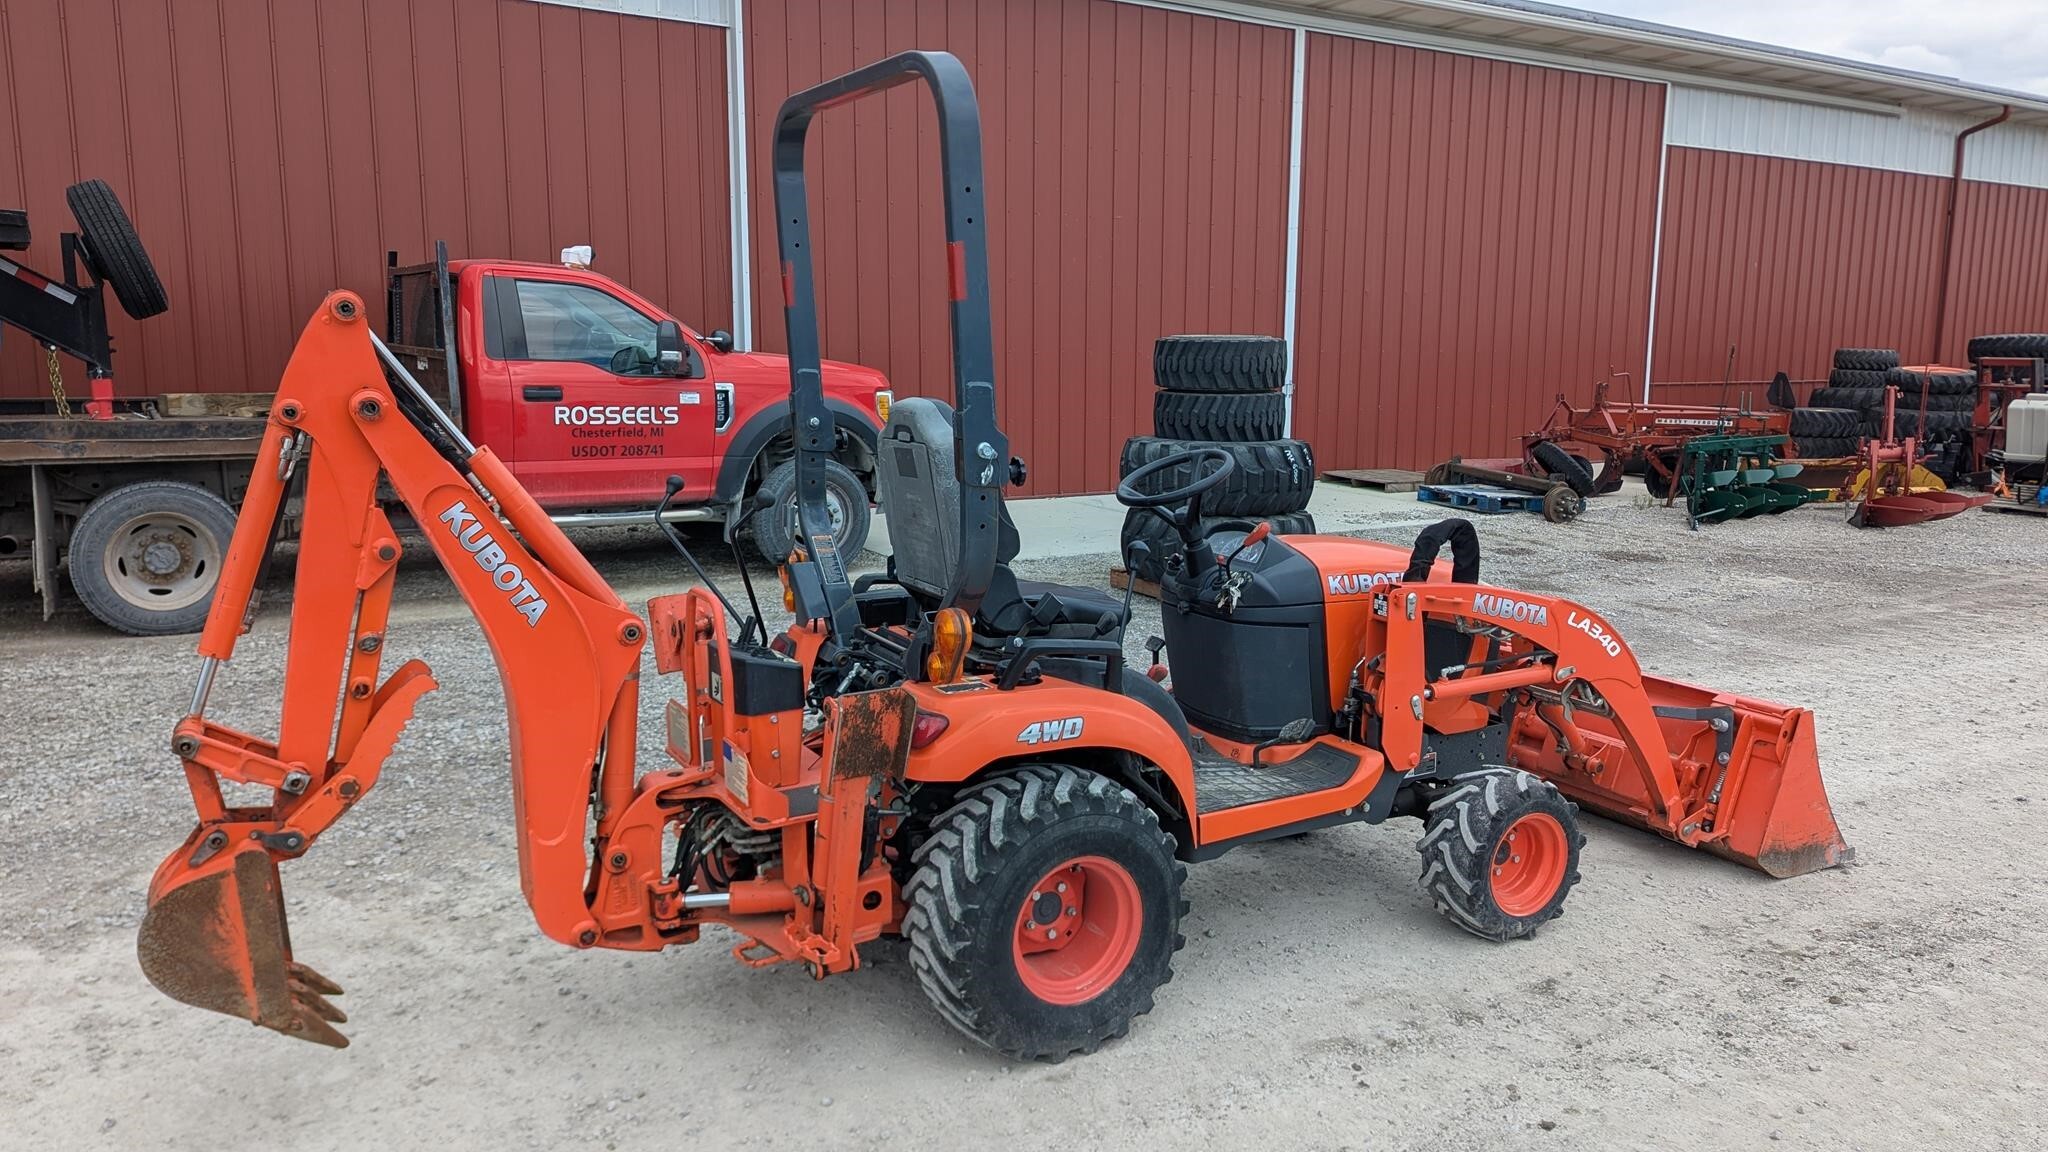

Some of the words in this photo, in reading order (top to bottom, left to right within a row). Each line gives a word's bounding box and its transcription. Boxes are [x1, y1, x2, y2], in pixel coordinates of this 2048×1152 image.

[554, 405, 680, 425] ROSSEEL'S
[571, 427, 648, 439] Chesterfield,
[650, 427, 664, 438] MI
[571, 445, 617, 457] USDOT
[621, 445, 664, 457] 208741
[439, 501, 549, 629] KUBOTA
[1327, 572, 1404, 595] KUBOT
[1472, 592, 1549, 627] KUBOTA
[1567, 611, 1622, 657] LA340
[1016, 716, 1085, 745] 4WD
